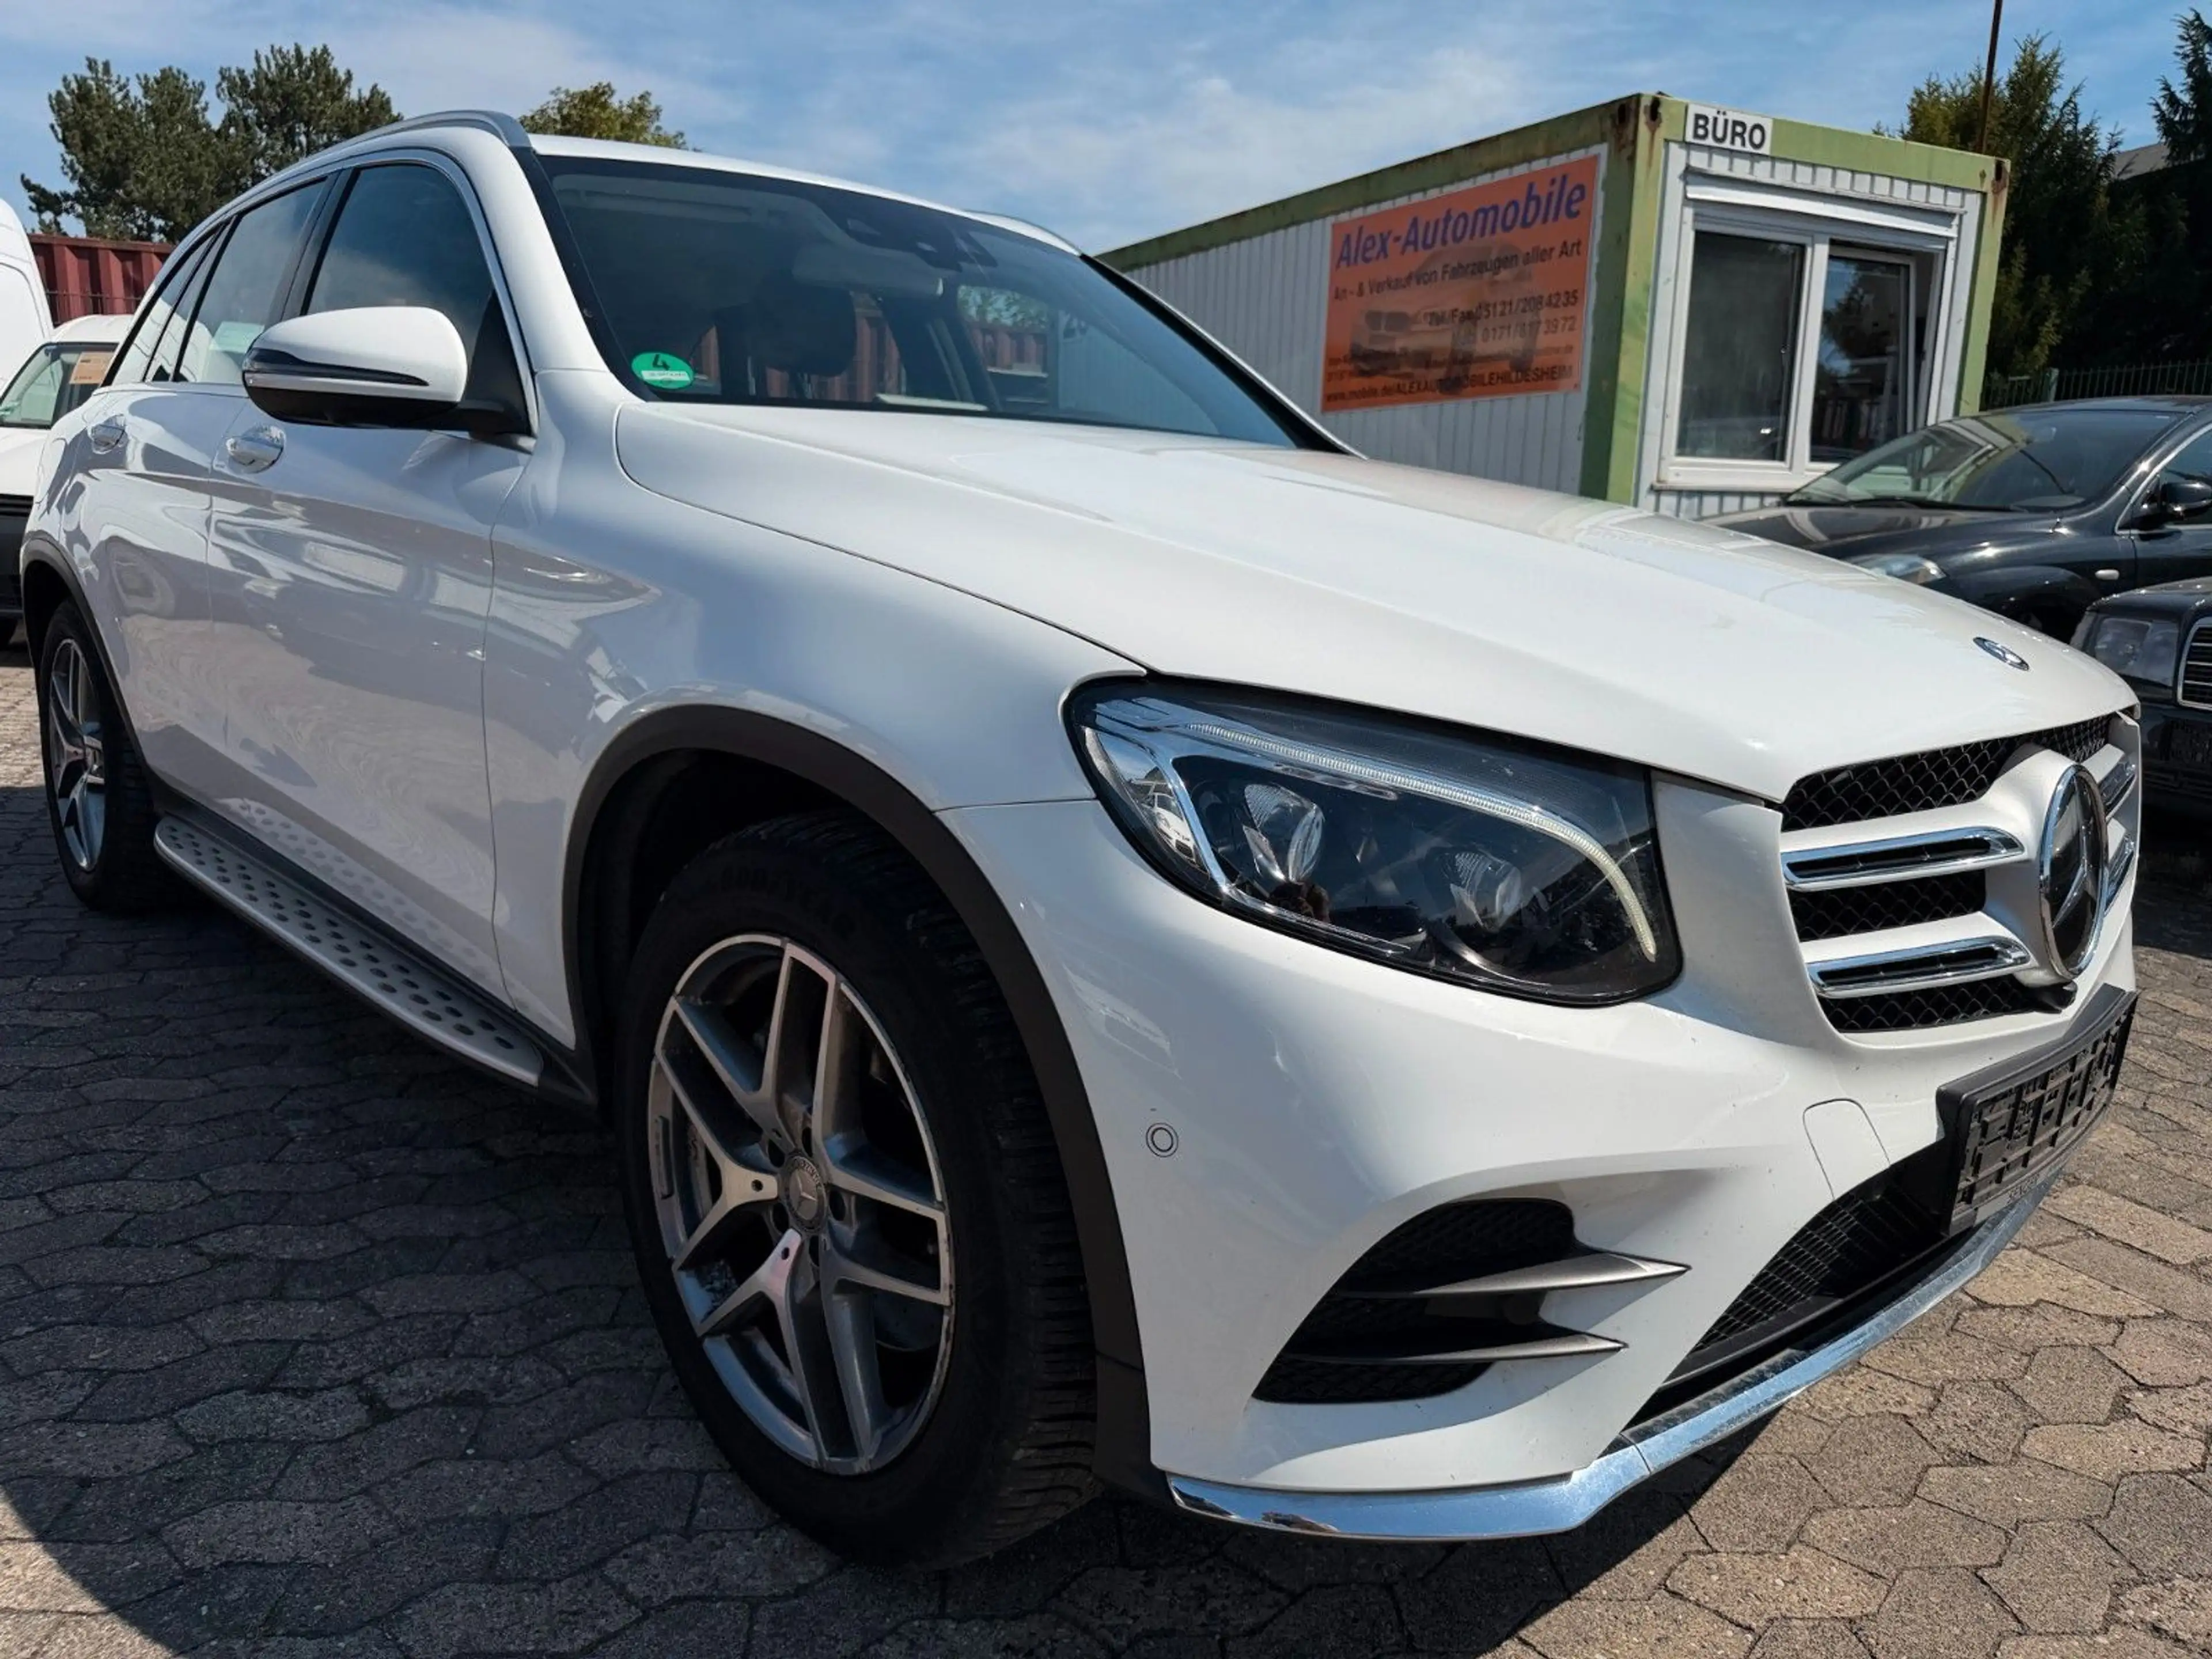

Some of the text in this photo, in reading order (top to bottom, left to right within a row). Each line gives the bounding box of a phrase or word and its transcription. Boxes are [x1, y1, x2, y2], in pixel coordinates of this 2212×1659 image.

[1692, 109, 1766, 150] BÜRO
[1336, 174, 1586, 271] Alex-Automobile
[1442, 252, 1518, 281] Fahrzeugen
[1522, 244, 1555, 266] aller
[1558, 237, 1582, 259] Art
[652, 354, 671, 370] 4
